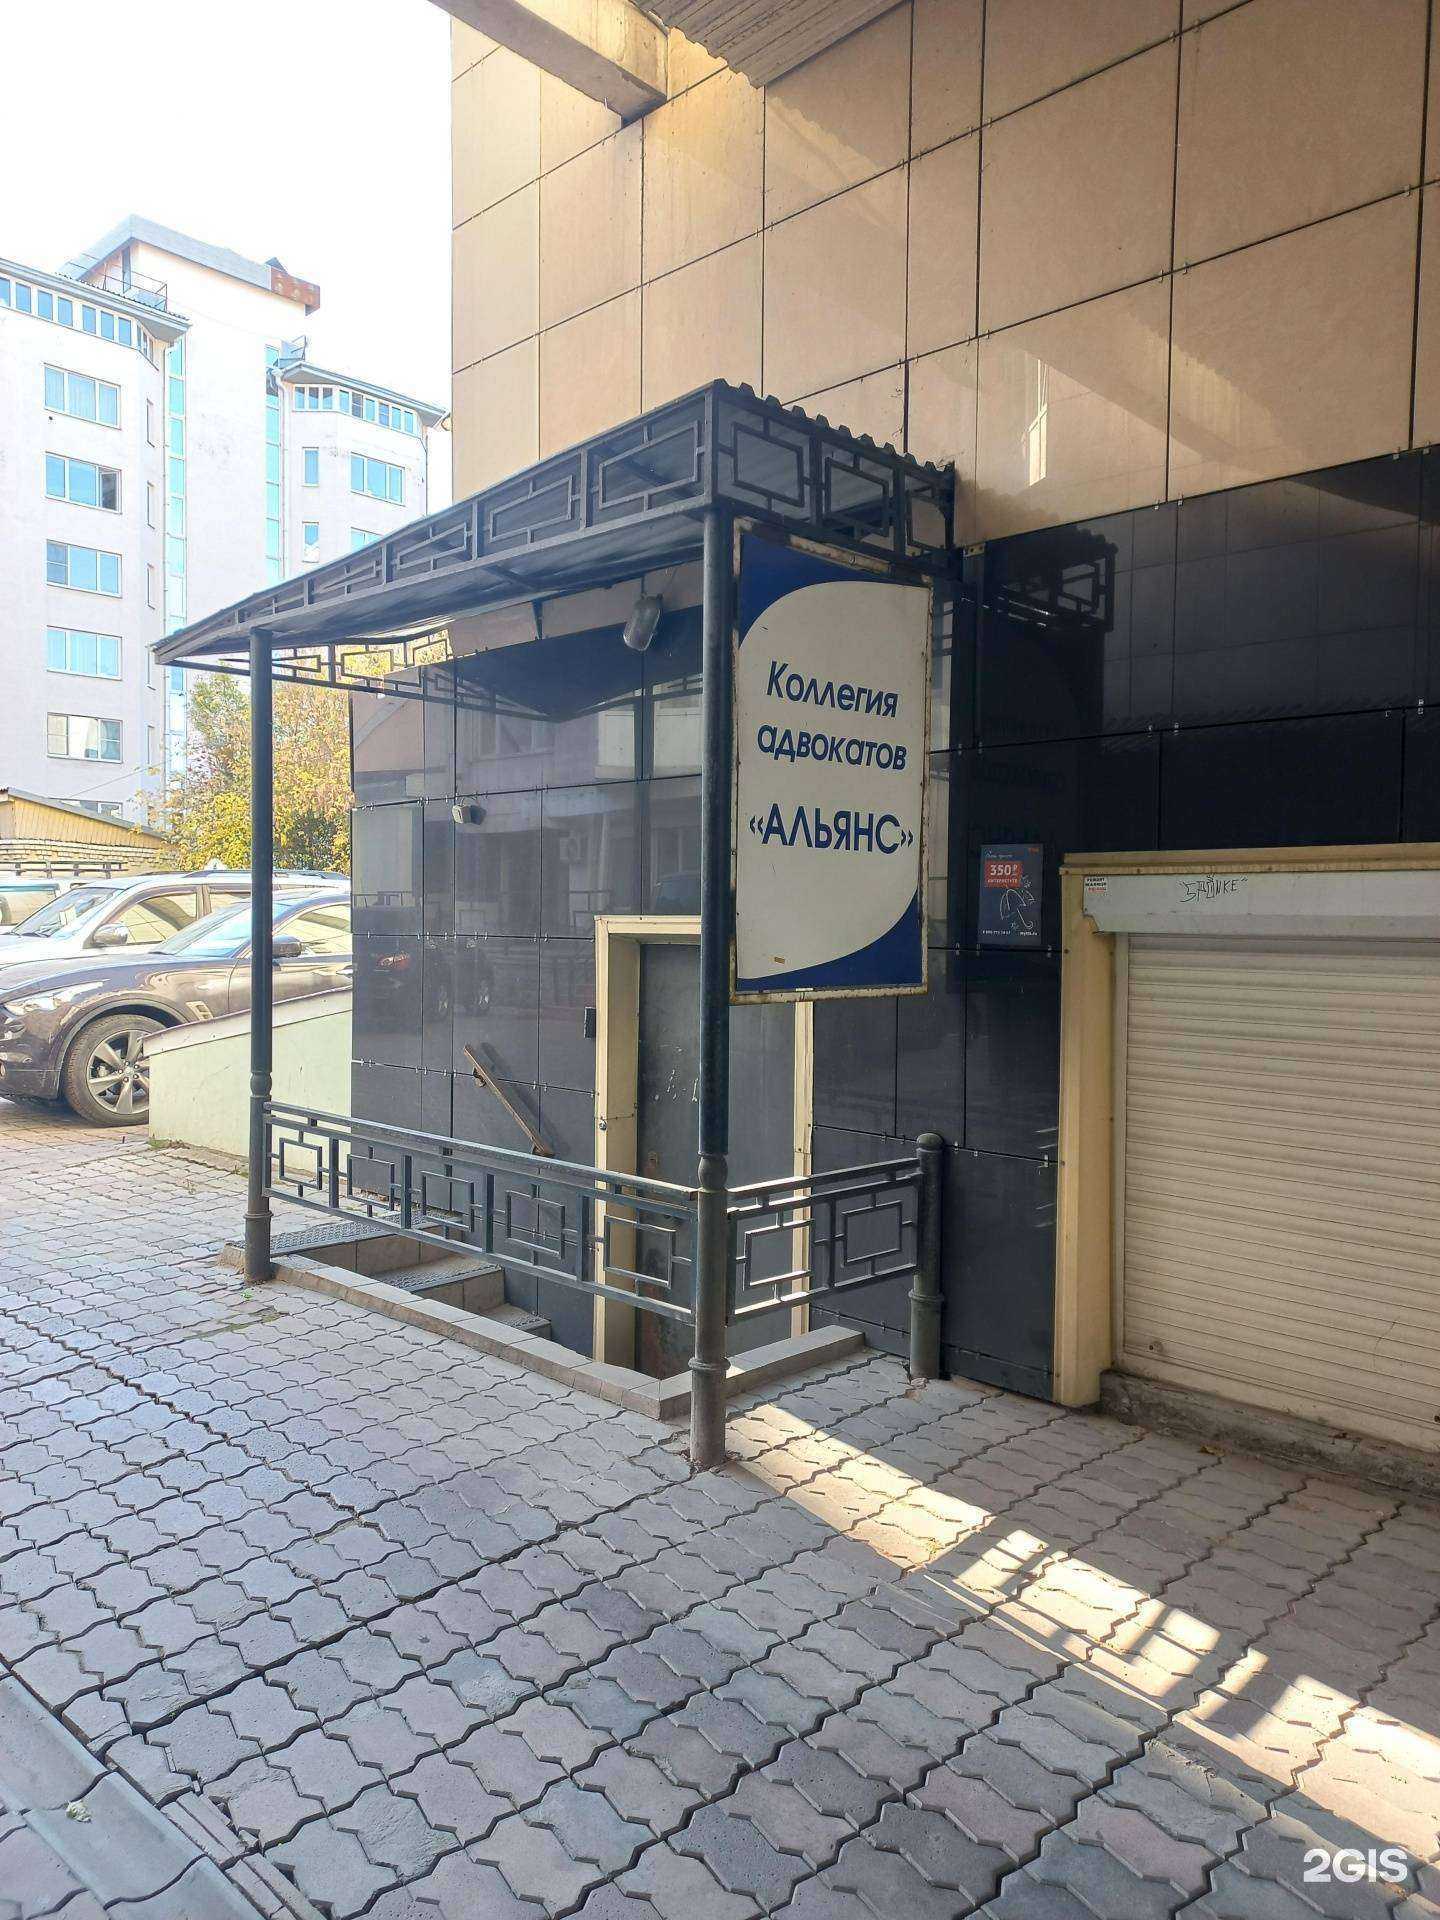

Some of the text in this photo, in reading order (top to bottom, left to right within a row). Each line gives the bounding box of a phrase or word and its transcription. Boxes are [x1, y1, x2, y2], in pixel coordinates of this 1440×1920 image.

[766, 660, 899, 718] Коллегия
[757, 724, 907, 770] адвокатов
[749, 803, 914, 854] «АЛЬЯНС»
